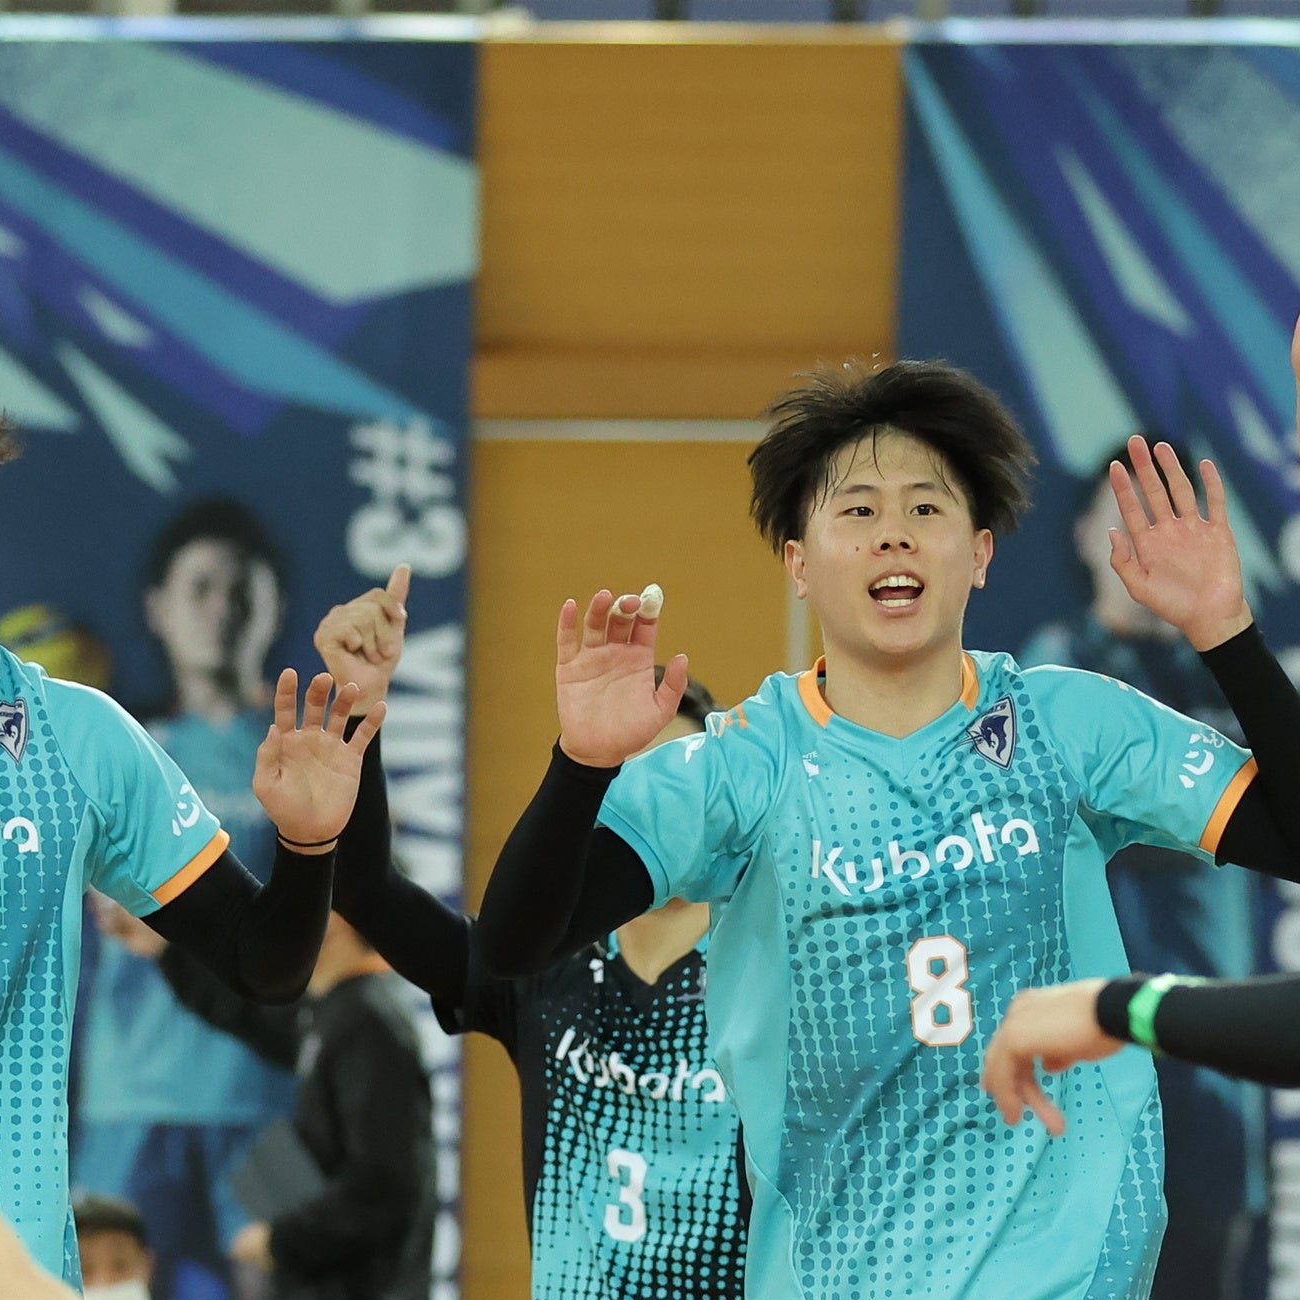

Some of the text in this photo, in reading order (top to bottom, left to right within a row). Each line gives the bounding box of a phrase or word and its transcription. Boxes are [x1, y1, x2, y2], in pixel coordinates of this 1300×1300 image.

[345, 418, 468, 579] #3
[811, 812, 1041, 897] Kubota
[906, 934, 975, 1048] 8
[555, 1027, 727, 1103] Kubota
[603, 1148, 648, 1242] 3
